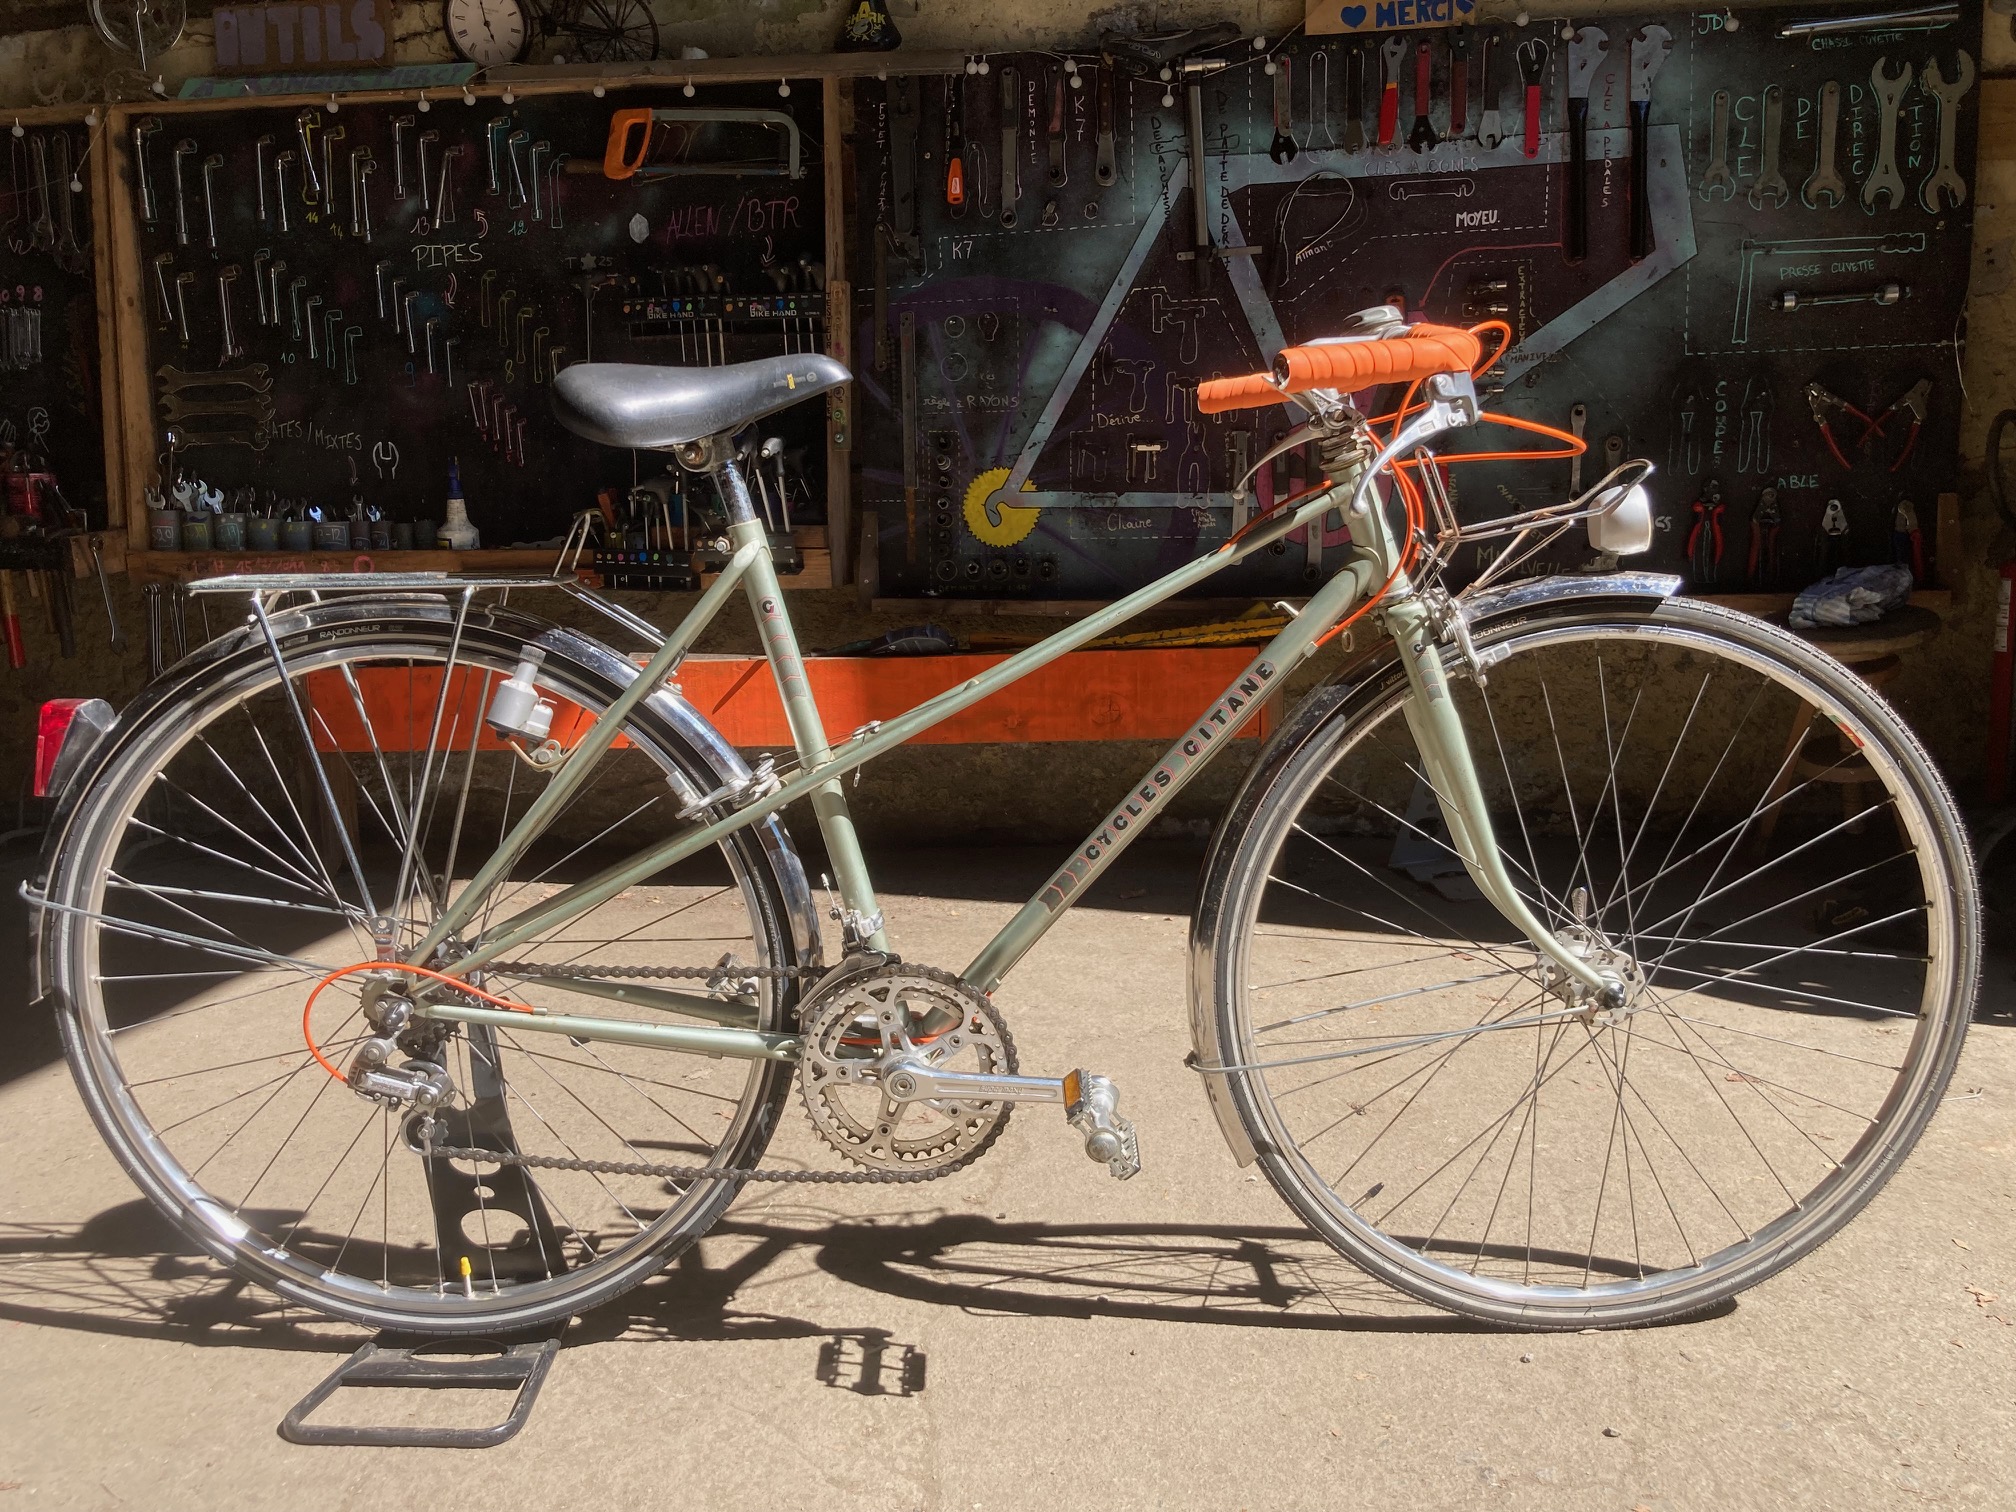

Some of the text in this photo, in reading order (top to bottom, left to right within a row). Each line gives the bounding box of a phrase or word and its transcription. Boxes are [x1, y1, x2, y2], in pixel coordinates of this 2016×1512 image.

[1375, 0, 1455, 28] MERCI
[1028, 80, 1037, 164] DEMONTE
[1600, 136, 1613, 208] PEDALES
[411, 242, 483, 271] PIPES
[951, 240, 974, 260] K7
[1779, 260, 1875, 281] PRESSE CUVETTE
[966, 394, 1020, 410] RAYONS
[315, 428, 363, 451] MIXTES
[319, 624, 381, 639] RANDONNEUR
[1085, 770, 1172, 860] CYCLES
